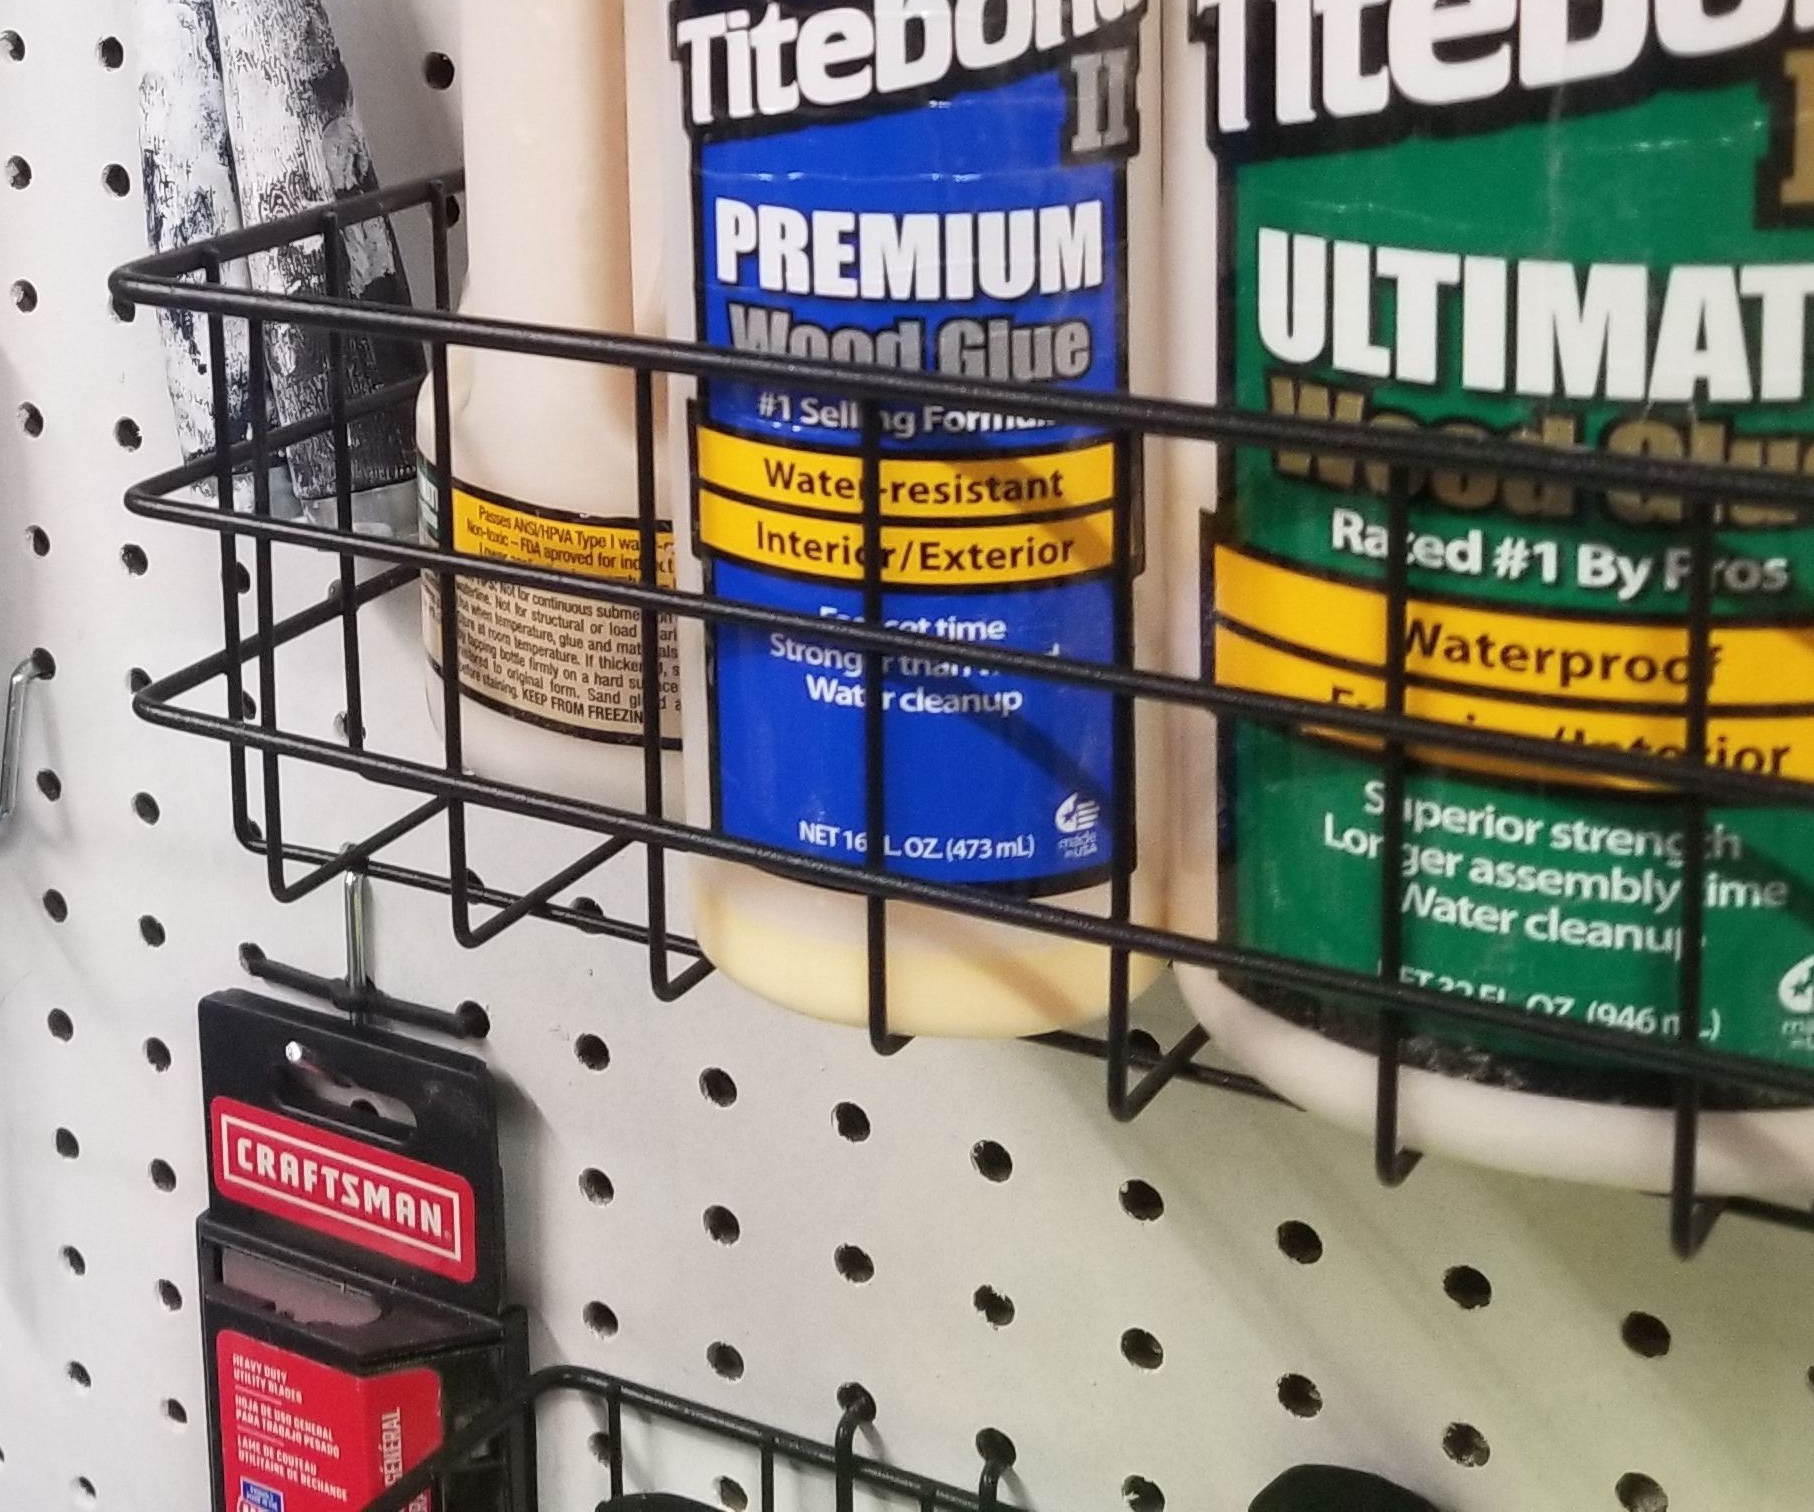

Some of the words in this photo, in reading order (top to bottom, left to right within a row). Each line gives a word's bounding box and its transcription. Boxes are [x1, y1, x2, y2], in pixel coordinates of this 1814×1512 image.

[1071, 49, 1131, 152] II
[715, 198, 1102, 301] PREMIUM
[728, 303, 923, 372] Wood
[938, 318, 1091, 382] Glue
[757, 391, 792, 421] #1
[800, 396, 915, 438] Sellng
[923, 405, 1057, 433] Form
[763, 457, 1064, 505] Wate-resistant
[520, 536, 541, 558] FDA
[597, 551, 617, 569] for
[574, 530, 606, 551] Type
[1331, 506, 1482, 575] Raed
[1492, 535, 1558, 583] #1
[1576, 543, 1651, 600] By
[530, 609, 585, 633] structural
[589, 623, 604, 635] or
[609, 621, 638, 639] load
[532, 593, 593, 617] continuous
[558, 631, 584, 649] glue
[587, 638, 612, 653] and
[936, 614, 1007, 642] time
[514, 635, 580, 666] temperature.
[585, 652, 594, 668] If
[769, 632, 895, 678] Strongr
[506, 667, 544, 690] original
[549, 678, 580, 700] form.
[587, 687, 621, 705] Sand
[562, 668, 577, 682] on
[594, 671, 624, 688] hard
[805, 673, 896, 710] Watr
[899, 687, 1024, 717] cleanup
[521, 687, 548, 706] KEEP
[550, 695, 585, 717] FROM
[587, 704, 645, 724] FREEZIN
[798, 820, 841, 848] NET
[842, 830, 868, 853] 16
[946, 837, 992, 863] (473
[996, 833, 1035, 859] mL)
[1550, 819, 1744, 867] strengh
[1468, 855, 1682, 915] assembly
[1702, 871, 1790, 909] ime
[1585, 999, 1657, 1036] (946
[236, 1137, 444, 1239] CRAFTSMAN
[232, 1352, 263, 1377] HEAVY
[264, 1364, 287, 1385] DUTY
[233, 1368, 266, 1392] UTILITY
[267, 1379, 303, 1405] BLADES
[234, 1394, 259, 1414] HOJA
[260, 1403, 273, 1419] DE
[274, 1409, 292, 1425] USO
[293, 1415, 334, 1441] GENERAL
[235, 1408, 260, 1429] PARA
[261, 1417, 302, 1445] TRABAJO
[303, 1433, 340, 1460] PESADO
[237, 1434, 262, 1455] LAME
[263, 1443, 275, 1459] DE
[276, 1449, 318, 1476] COUTEAU
[238, 1448, 286, 1479] UTILITAIRE
[286, 1467, 299, 1483] DE
[300, 1473, 348, 1503] RECHANGE
